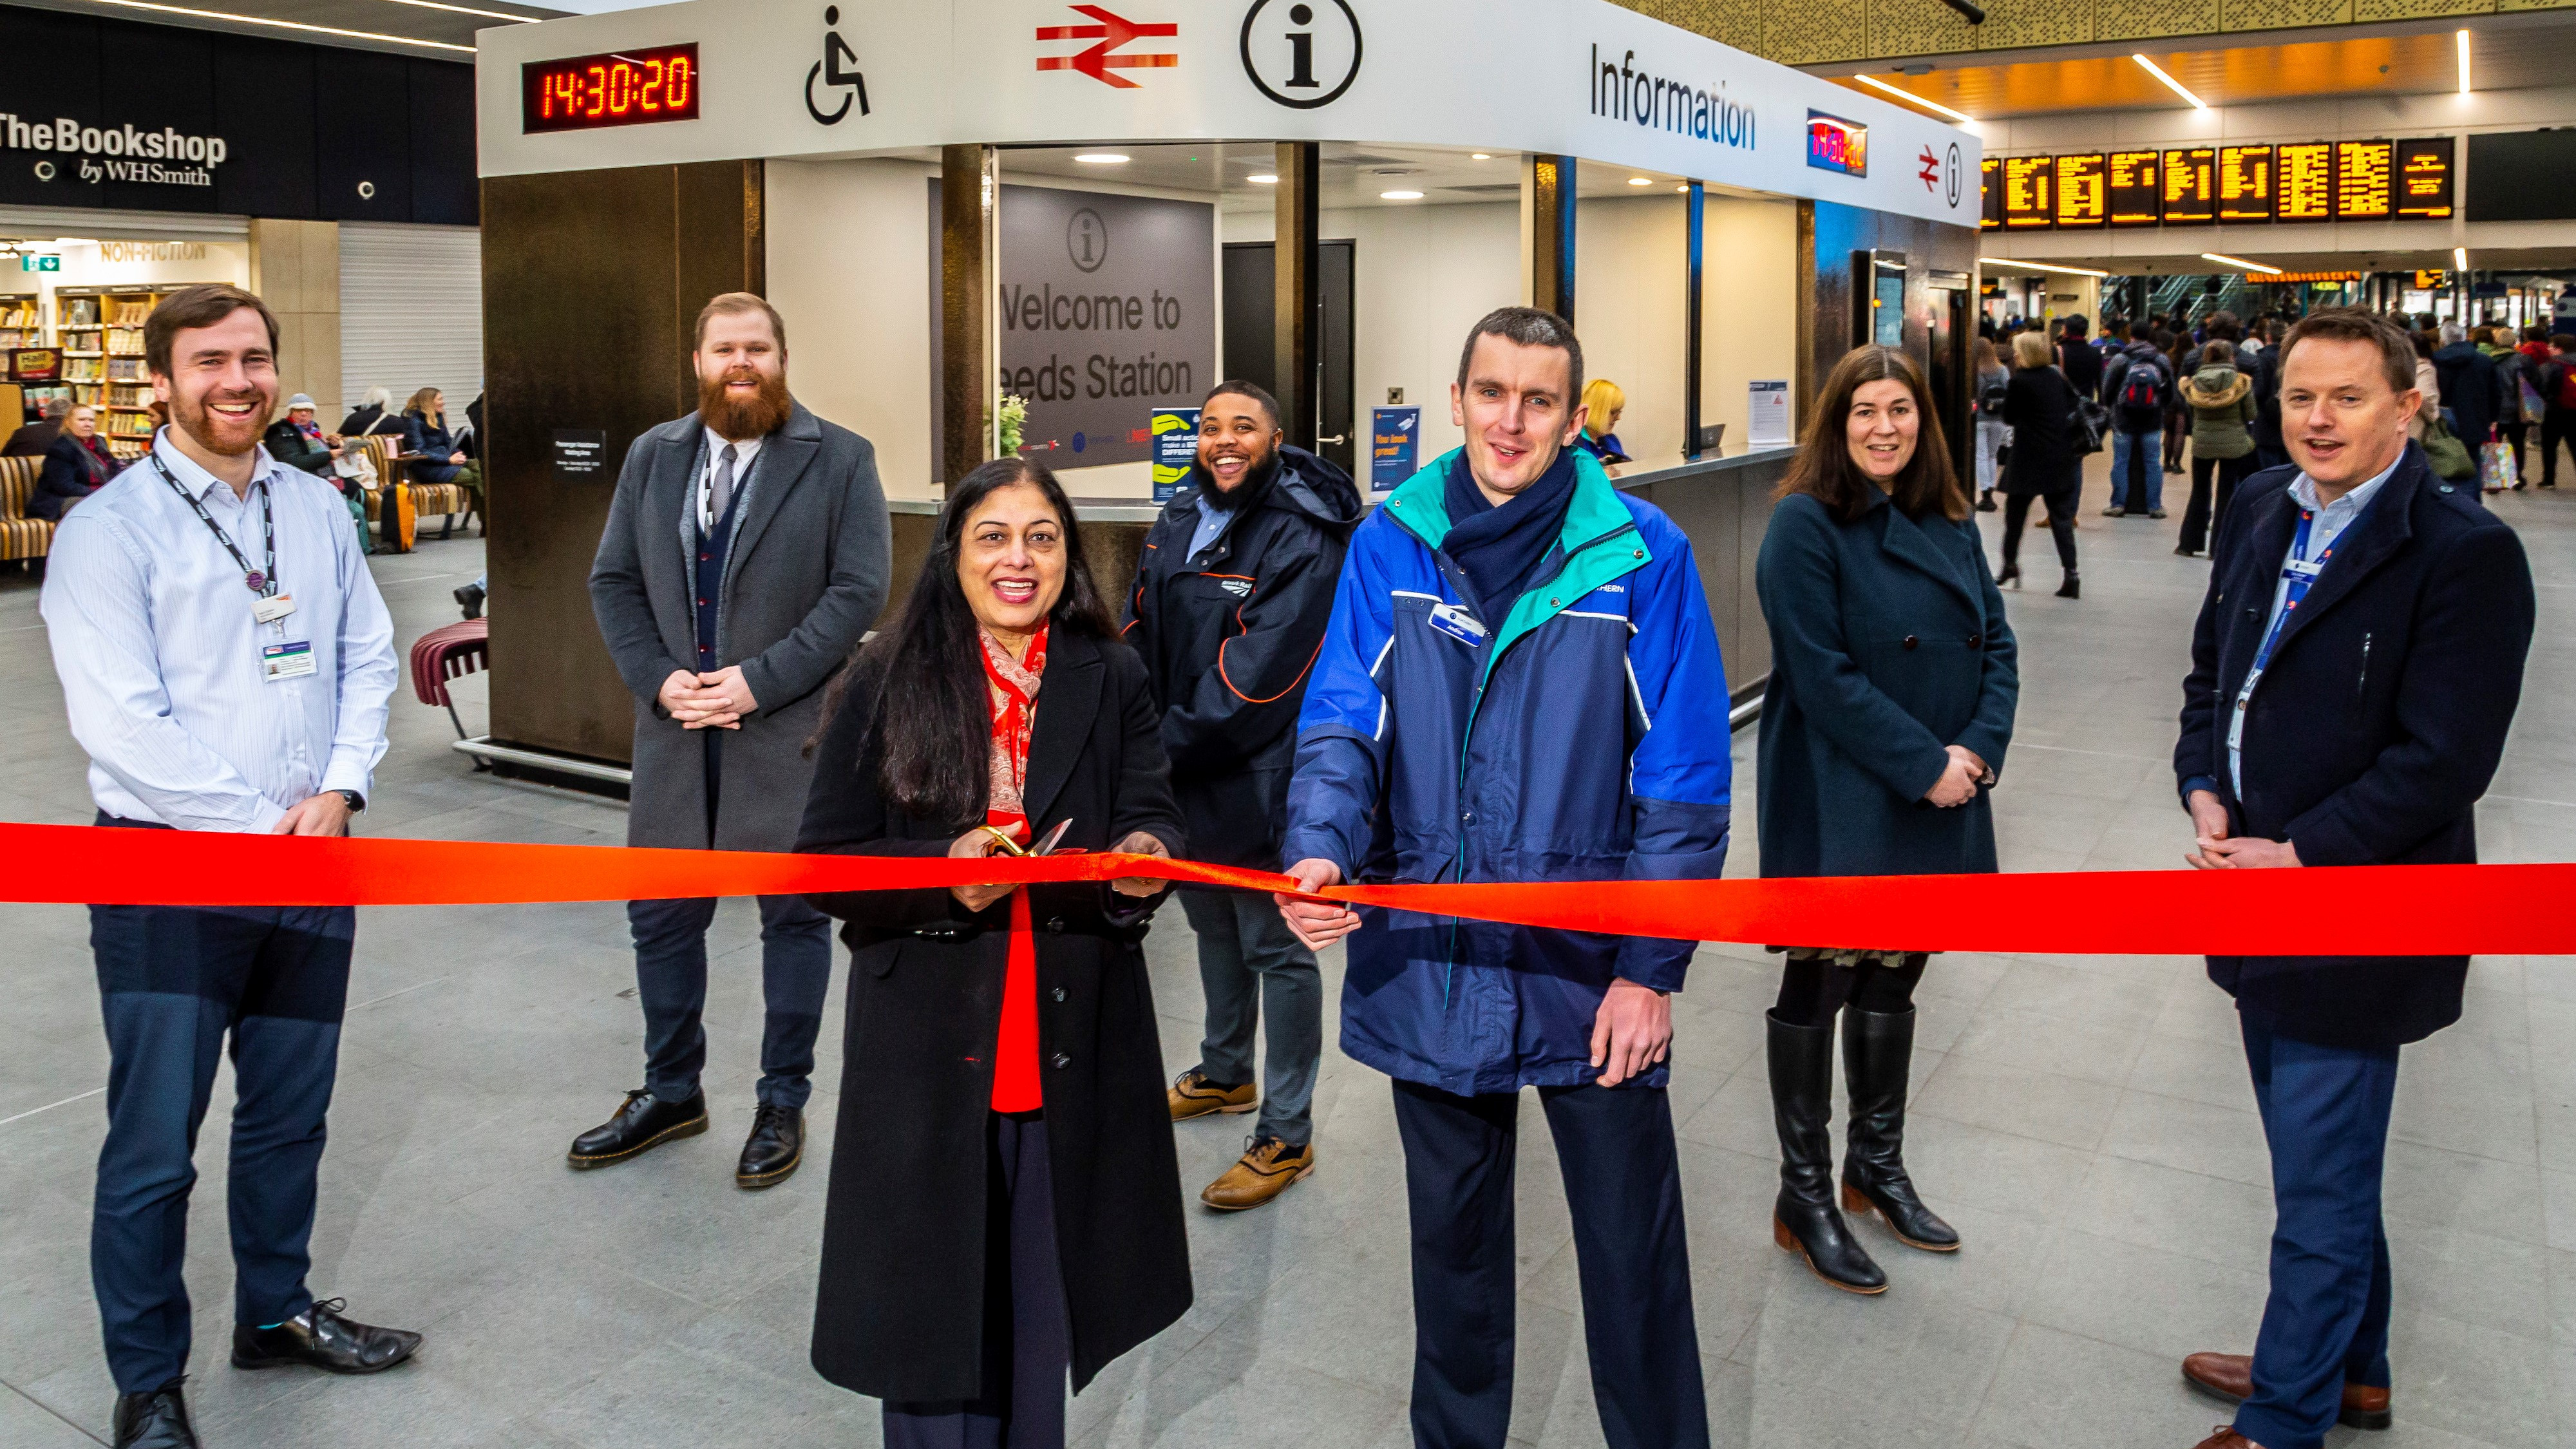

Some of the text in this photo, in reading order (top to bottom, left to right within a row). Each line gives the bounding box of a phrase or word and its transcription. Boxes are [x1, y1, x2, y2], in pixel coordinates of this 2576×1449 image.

[542, 55, 690, 118] 14:30:20
[1591, 43, 1755, 150] Information
[79, 159, 211, 185] by WHSmith
[100, 242, 206, 262] NON-FICTION
[1151, 289, 1180, 330] to
[1086, 351, 1191, 399] Station
